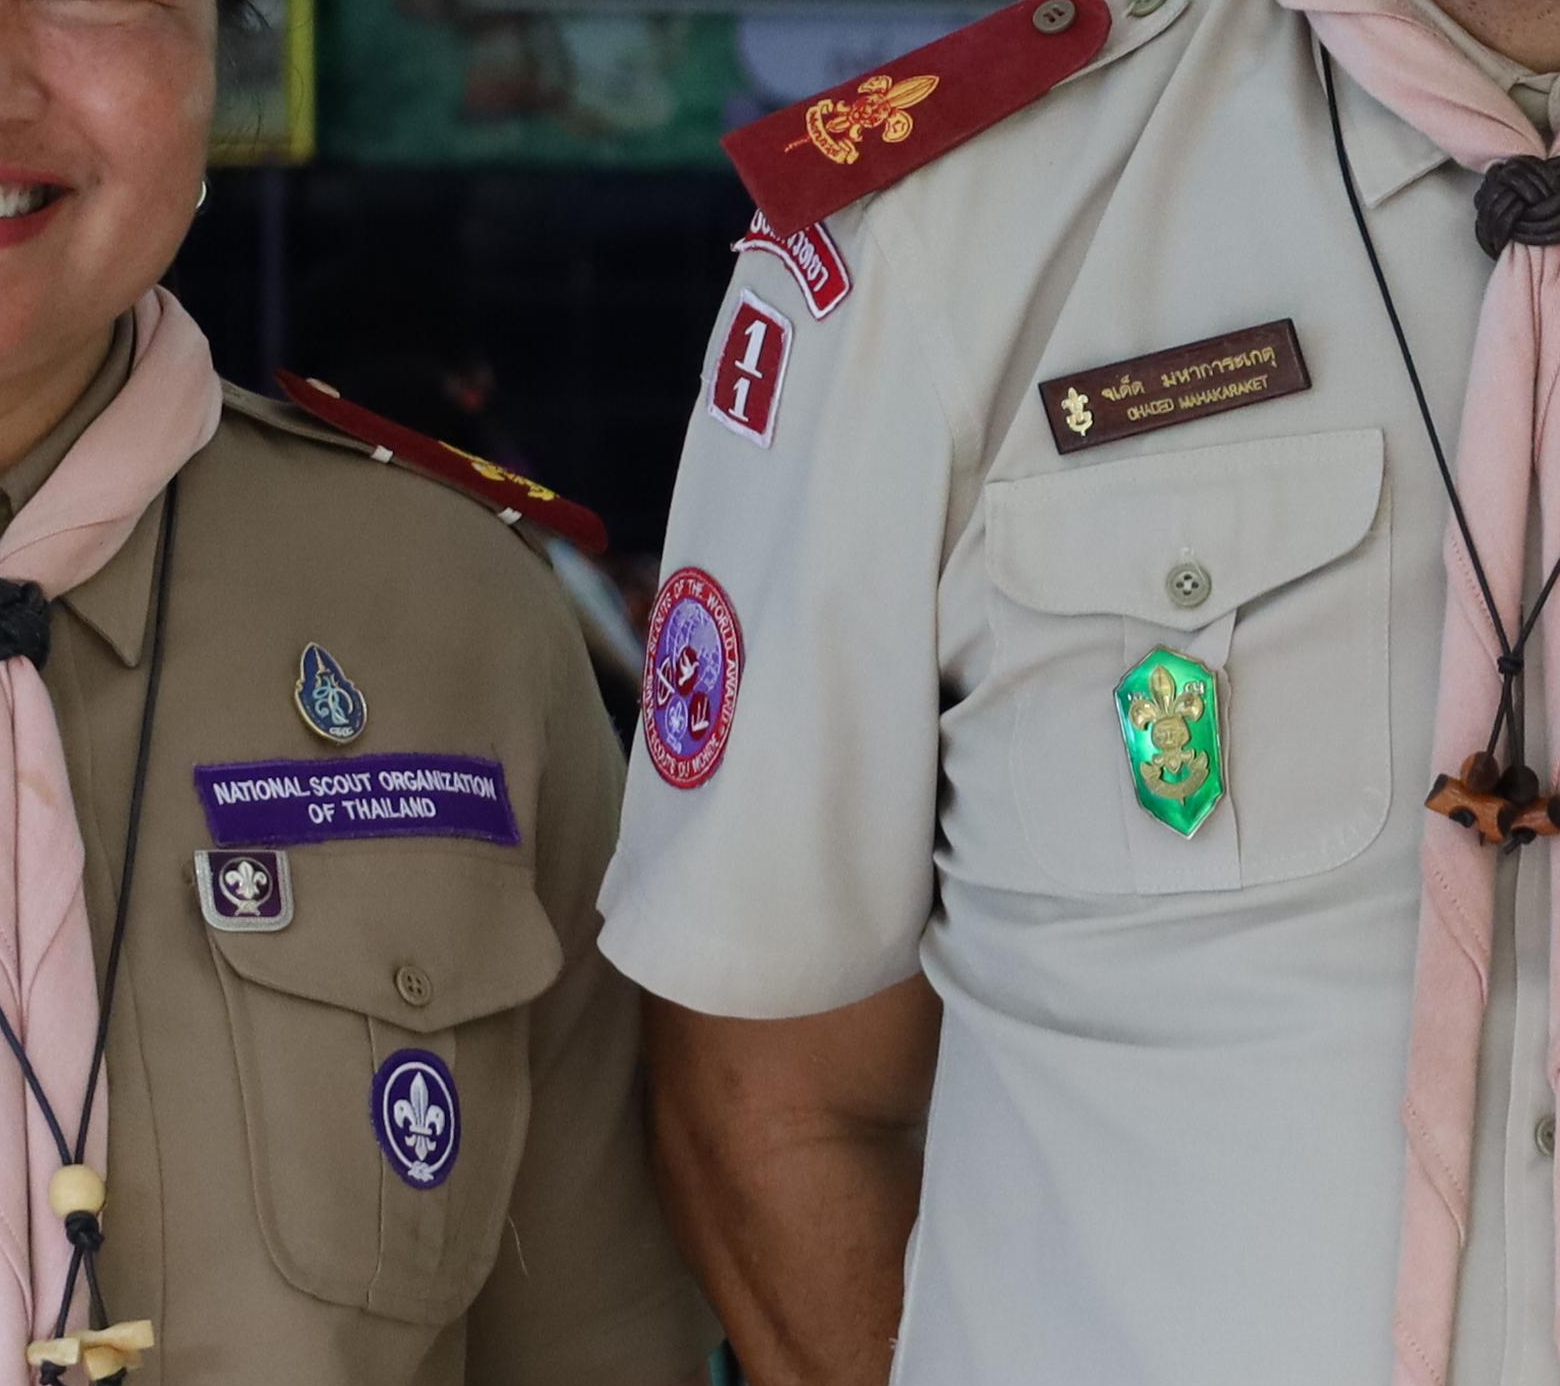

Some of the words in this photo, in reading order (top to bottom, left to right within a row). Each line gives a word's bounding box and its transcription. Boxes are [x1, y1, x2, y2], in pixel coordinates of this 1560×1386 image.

[735, 320, 767, 379] 1
[728, 377, 750, 422] 1
[1179, 374, 1268, 409] MAHAKARAKET
[706, 592, 736, 650] WORLD
[213, 776, 310, 805] NATIONAL
[309, 772, 371, 796] SCOUT
[378, 770, 497, 801] ORGANIZATION
[308, 802, 335, 824] OF
[342, 797, 437, 820] THAILAND
